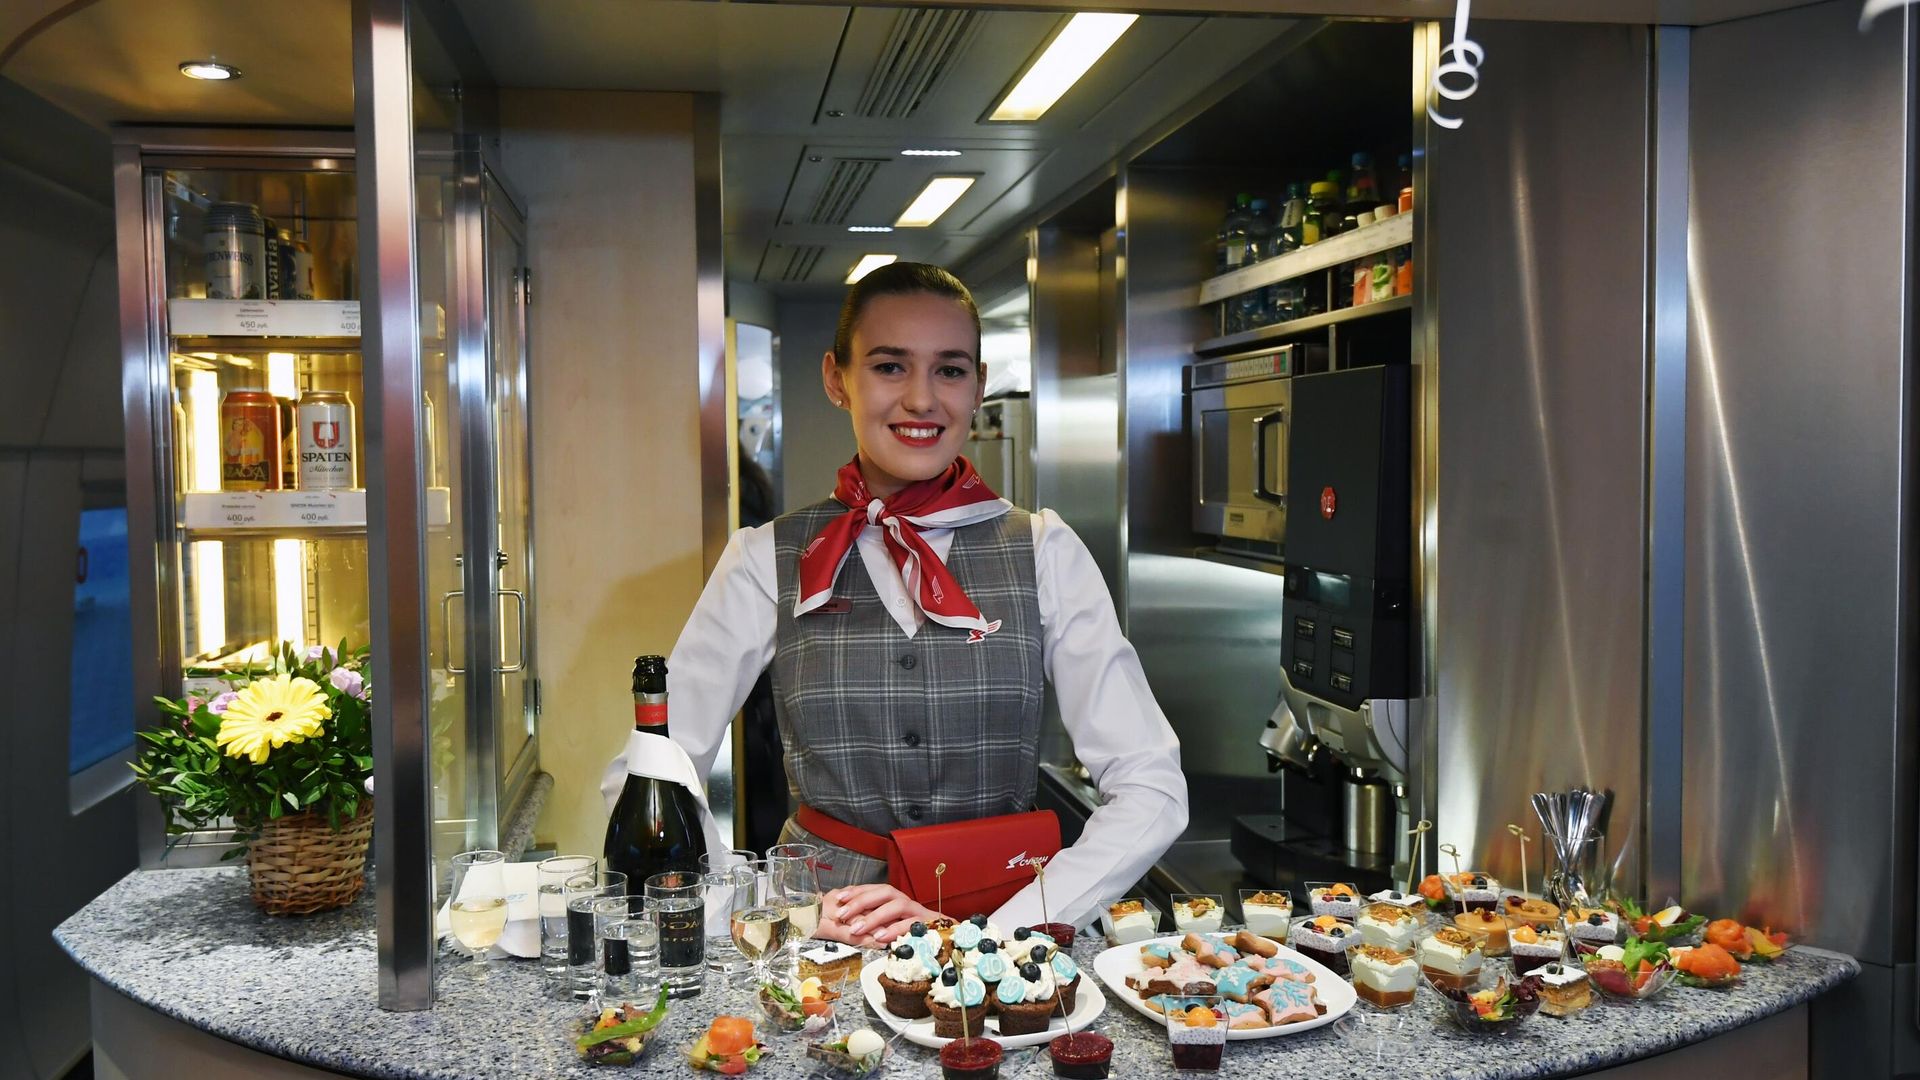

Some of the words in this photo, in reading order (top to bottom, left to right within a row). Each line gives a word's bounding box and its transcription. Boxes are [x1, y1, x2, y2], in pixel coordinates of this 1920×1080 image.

[240, 320, 256, 329] 450
[340, 322, 356, 330] 400
[301, 452, 351, 463] SPATEN
[227, 514, 242, 522] 400
[301, 513, 316, 521] 400
